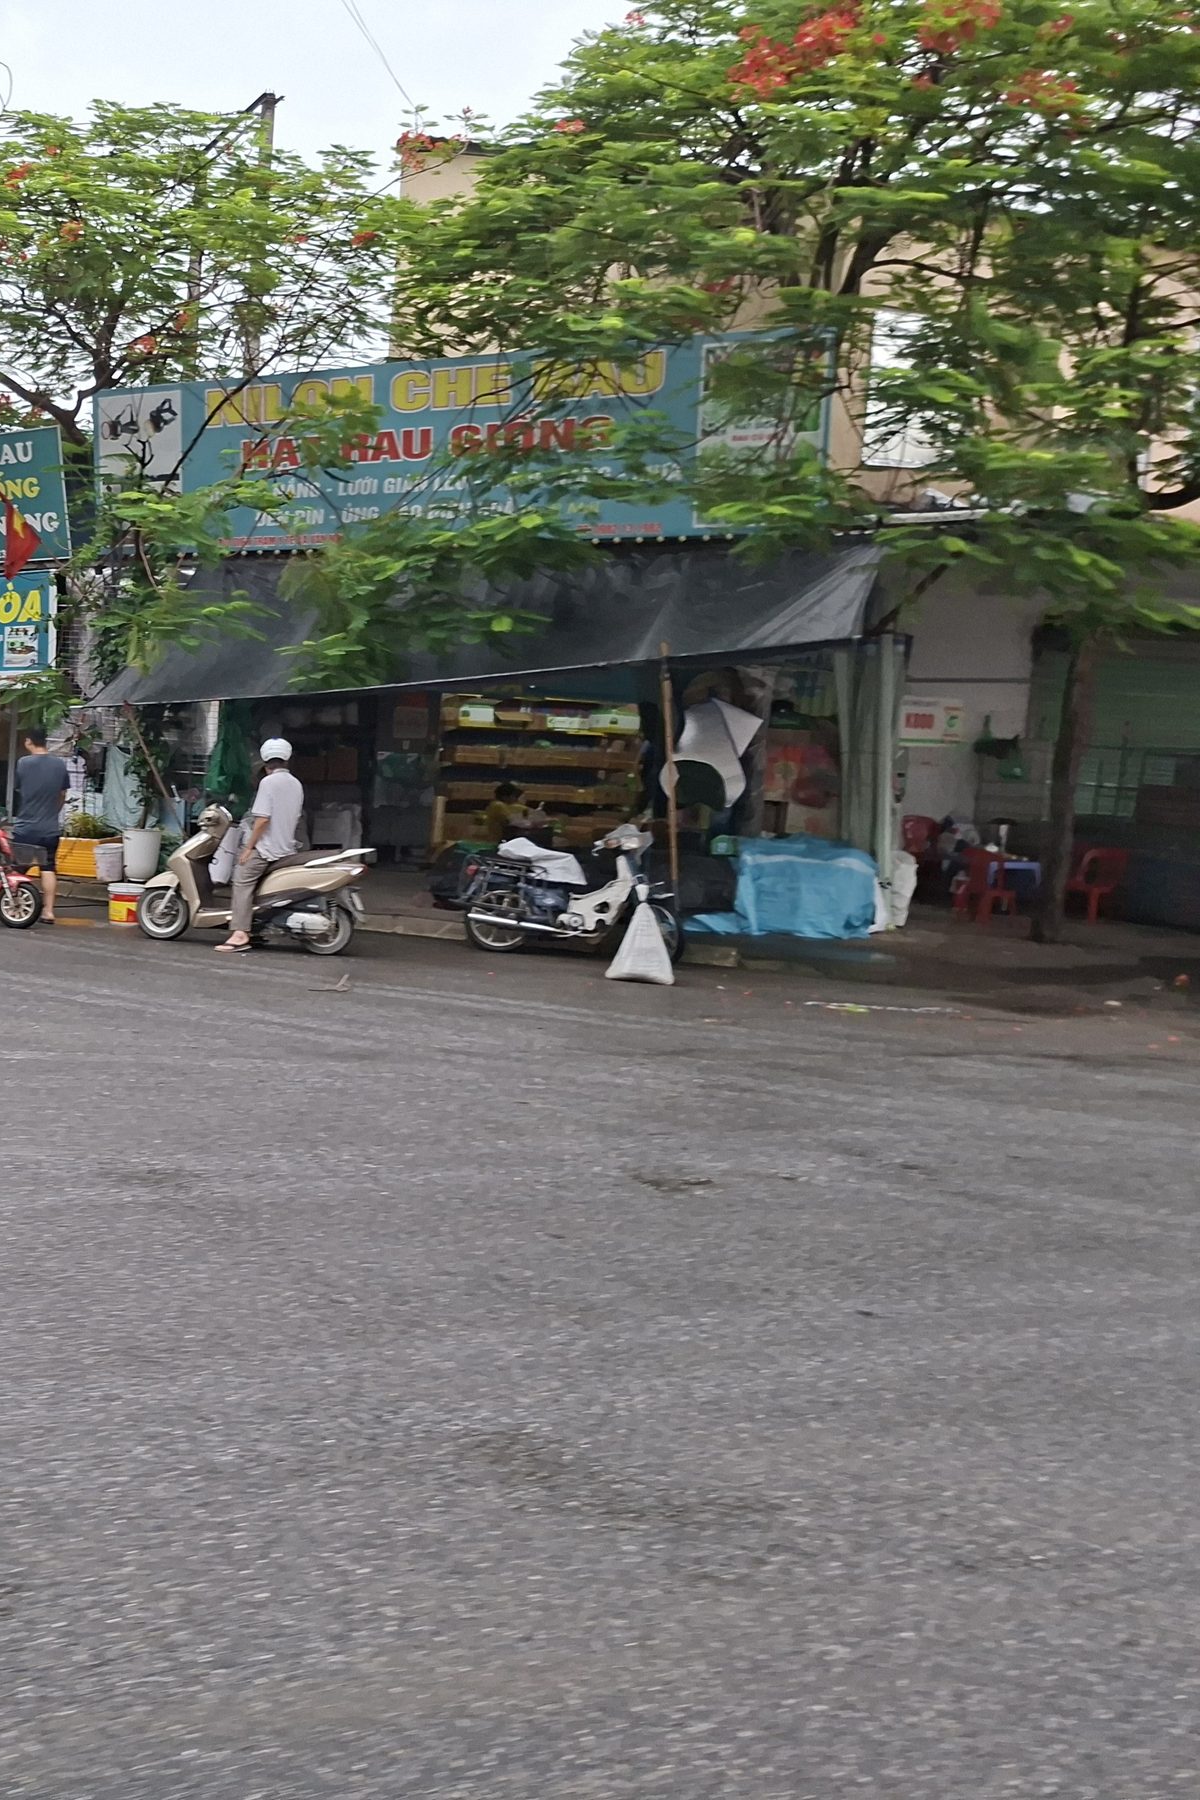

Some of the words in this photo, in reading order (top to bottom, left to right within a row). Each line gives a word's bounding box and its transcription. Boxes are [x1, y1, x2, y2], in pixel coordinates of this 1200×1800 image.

[391, 362, 512, 413] CHE
[531, 349, 666, 404] RAU
[338, 475, 378, 496] LƯỚI
